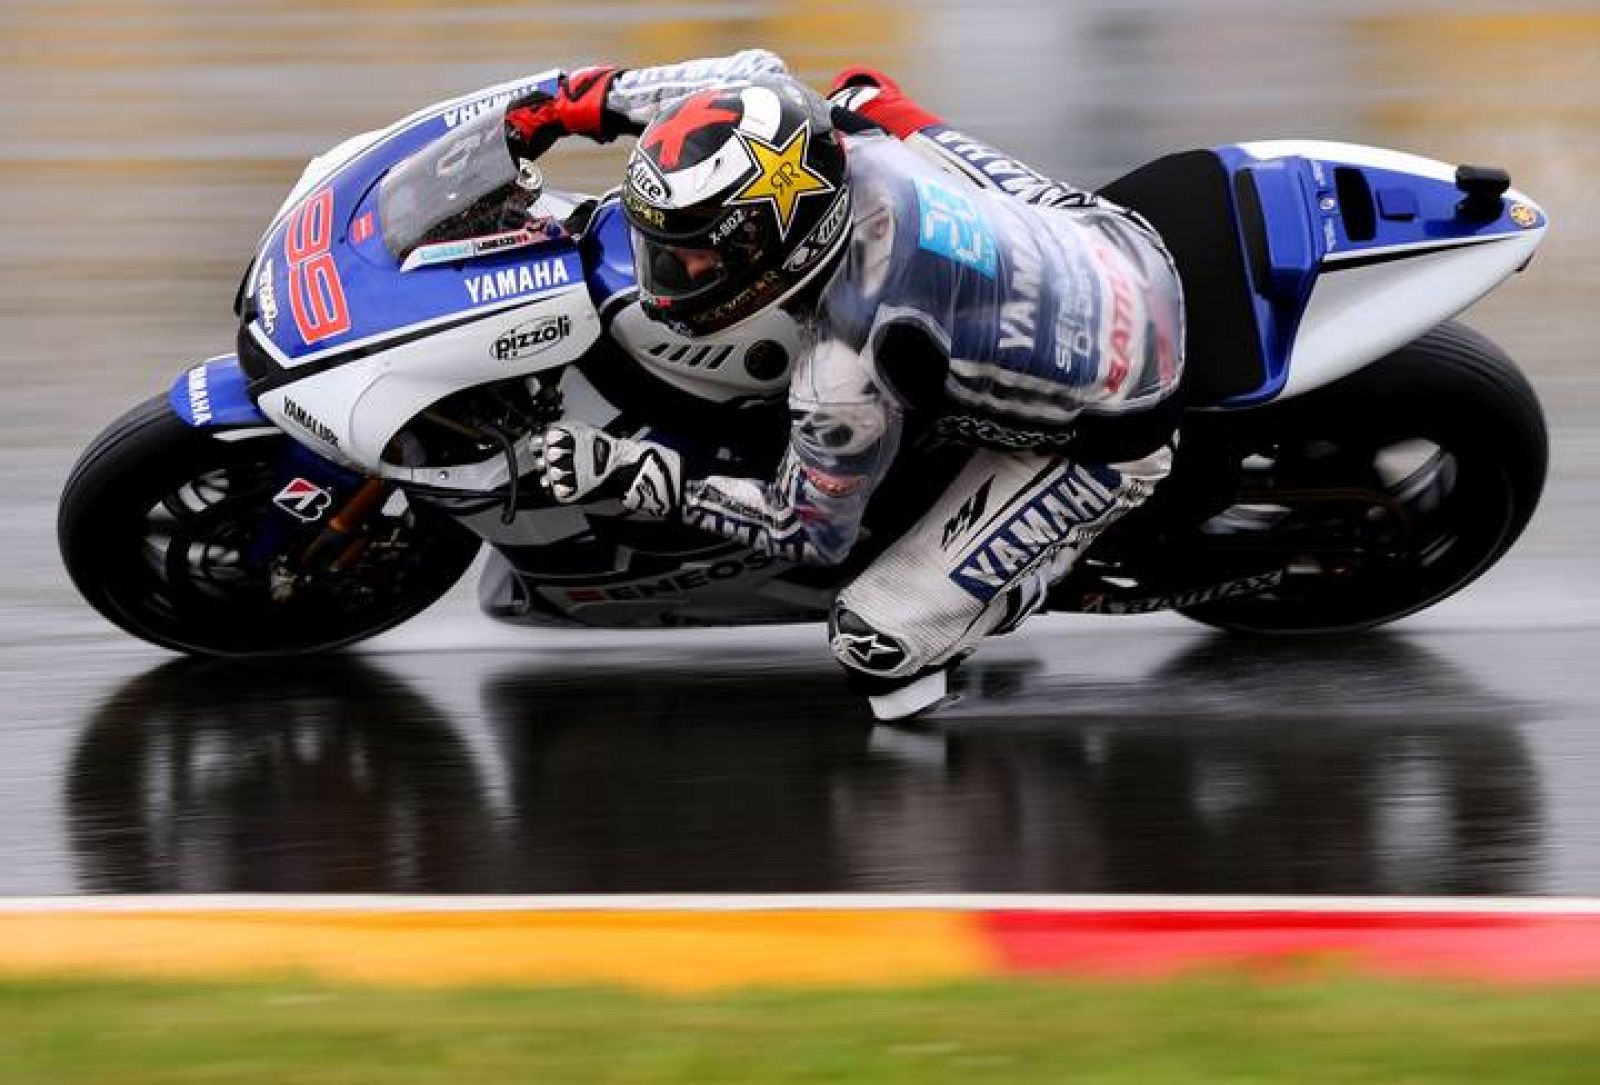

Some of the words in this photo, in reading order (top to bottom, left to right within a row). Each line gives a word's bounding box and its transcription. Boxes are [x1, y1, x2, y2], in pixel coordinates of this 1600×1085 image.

[284, 187, 351, 346] 99
[464, 257, 570, 304] YAMAHA
[497, 314, 570, 361] pizzoli
[188, 366, 212, 427] YAMAHA
